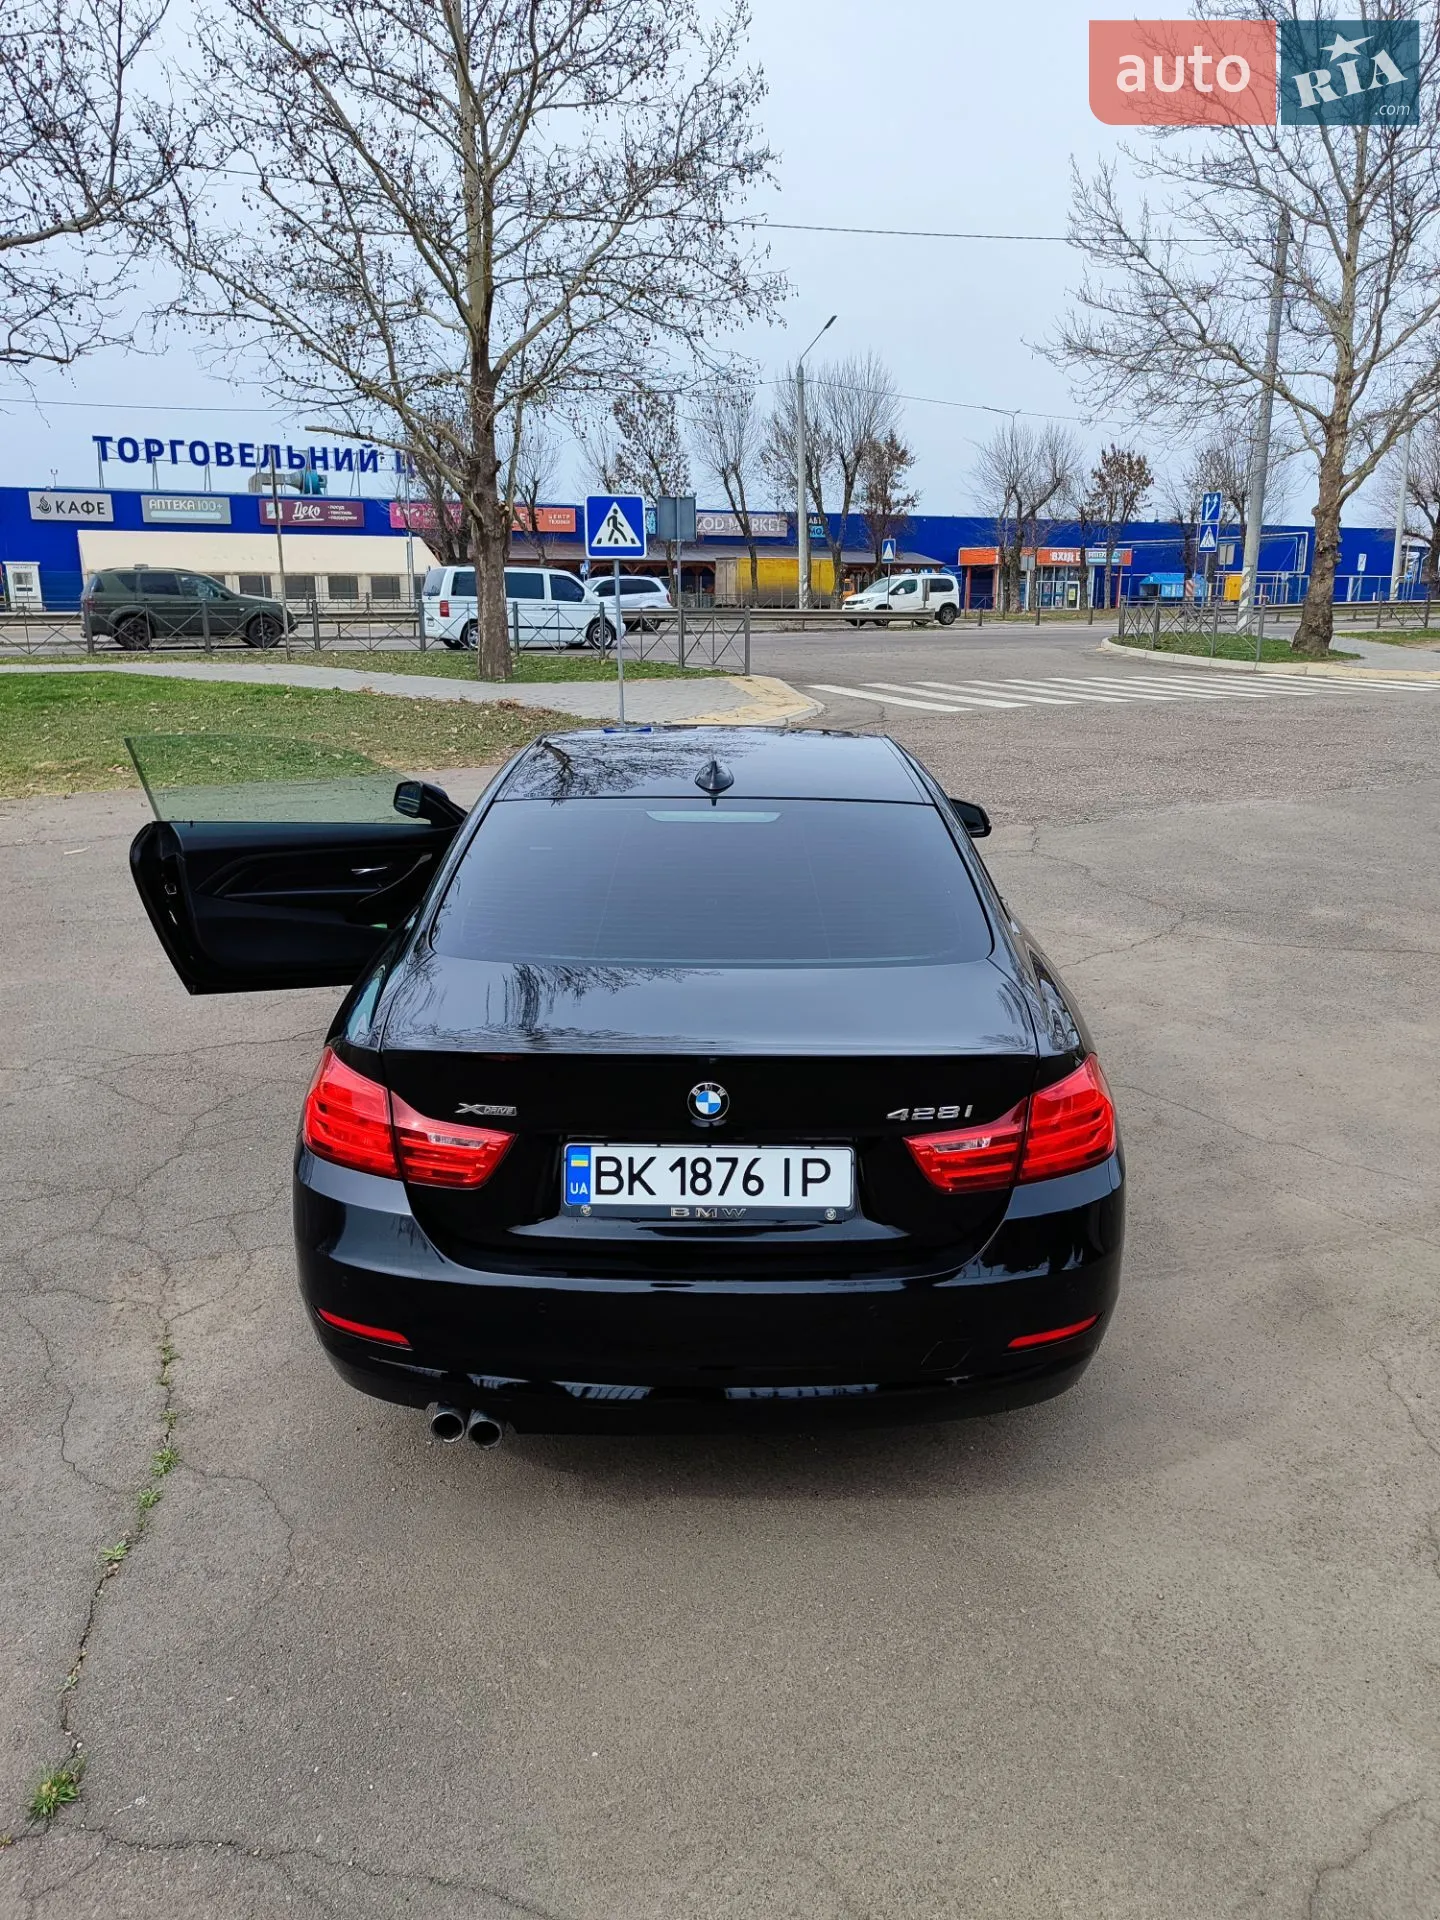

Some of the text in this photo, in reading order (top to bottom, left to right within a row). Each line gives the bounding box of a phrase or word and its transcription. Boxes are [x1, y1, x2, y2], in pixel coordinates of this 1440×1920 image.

[92, 435, 379, 473] ТОРГОВЕЛЬНИЙ
[55, 500, 106, 515] КАФЕ
[595, 1156, 831, 1197] BK 1876 IP
[570, 1182, 589, 1196] UA
[670, 1207, 747, 1218] BMW
